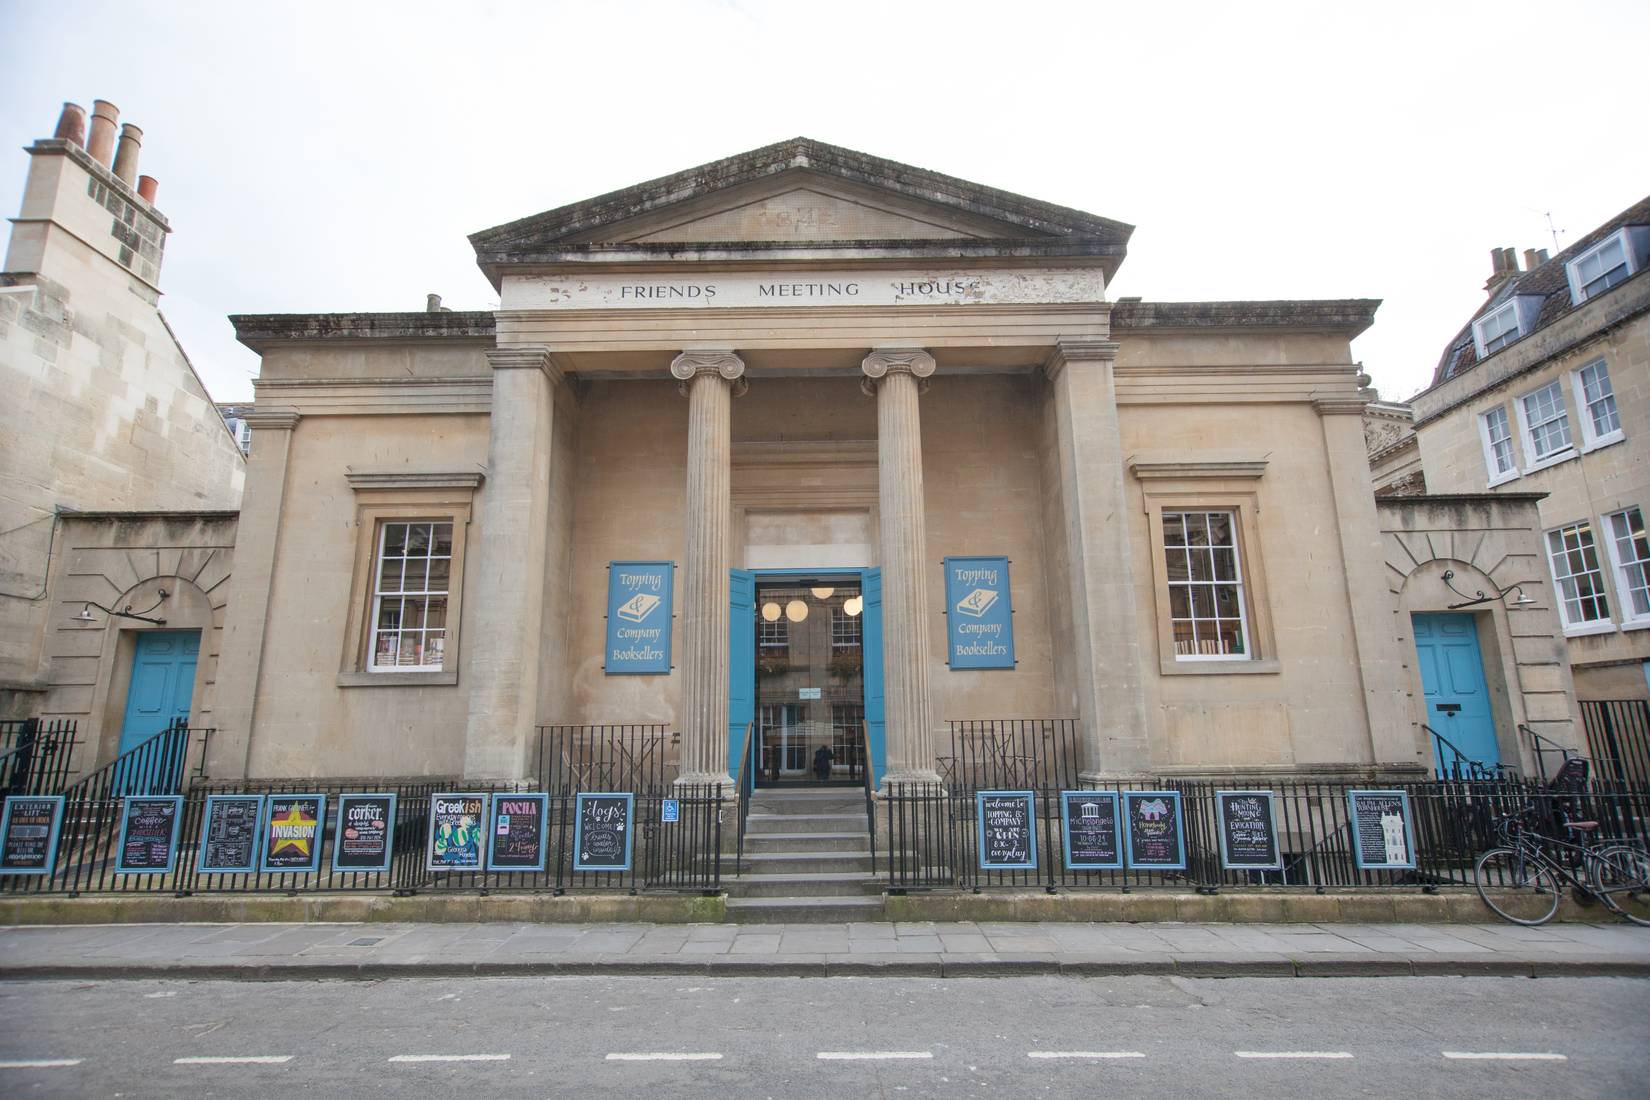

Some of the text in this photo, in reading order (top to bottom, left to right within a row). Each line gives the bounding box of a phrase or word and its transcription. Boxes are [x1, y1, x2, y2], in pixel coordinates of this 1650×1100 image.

[621, 285, 716, 299] FRIENDS
[759, 282, 859, 297] MEETING
[620, 573, 662, 591] Topping
[955, 568, 998, 586] Topping
[617, 628, 661, 643] Company
[959, 623, 1002, 639] Company
[613, 645, 664, 661] Booksellers
[956, 640, 1008, 656] Booksellers
[436, 799, 481, 814] Greekish
[502, 801, 537, 815] POCHA
[986, 798, 1015, 808] welcome
[1230, 802, 1261, 812] HUNTING
[587, 800, 620, 823] dogs
[988, 810, 1012, 818] TOPPING
[272, 825, 315, 838] INVASION
